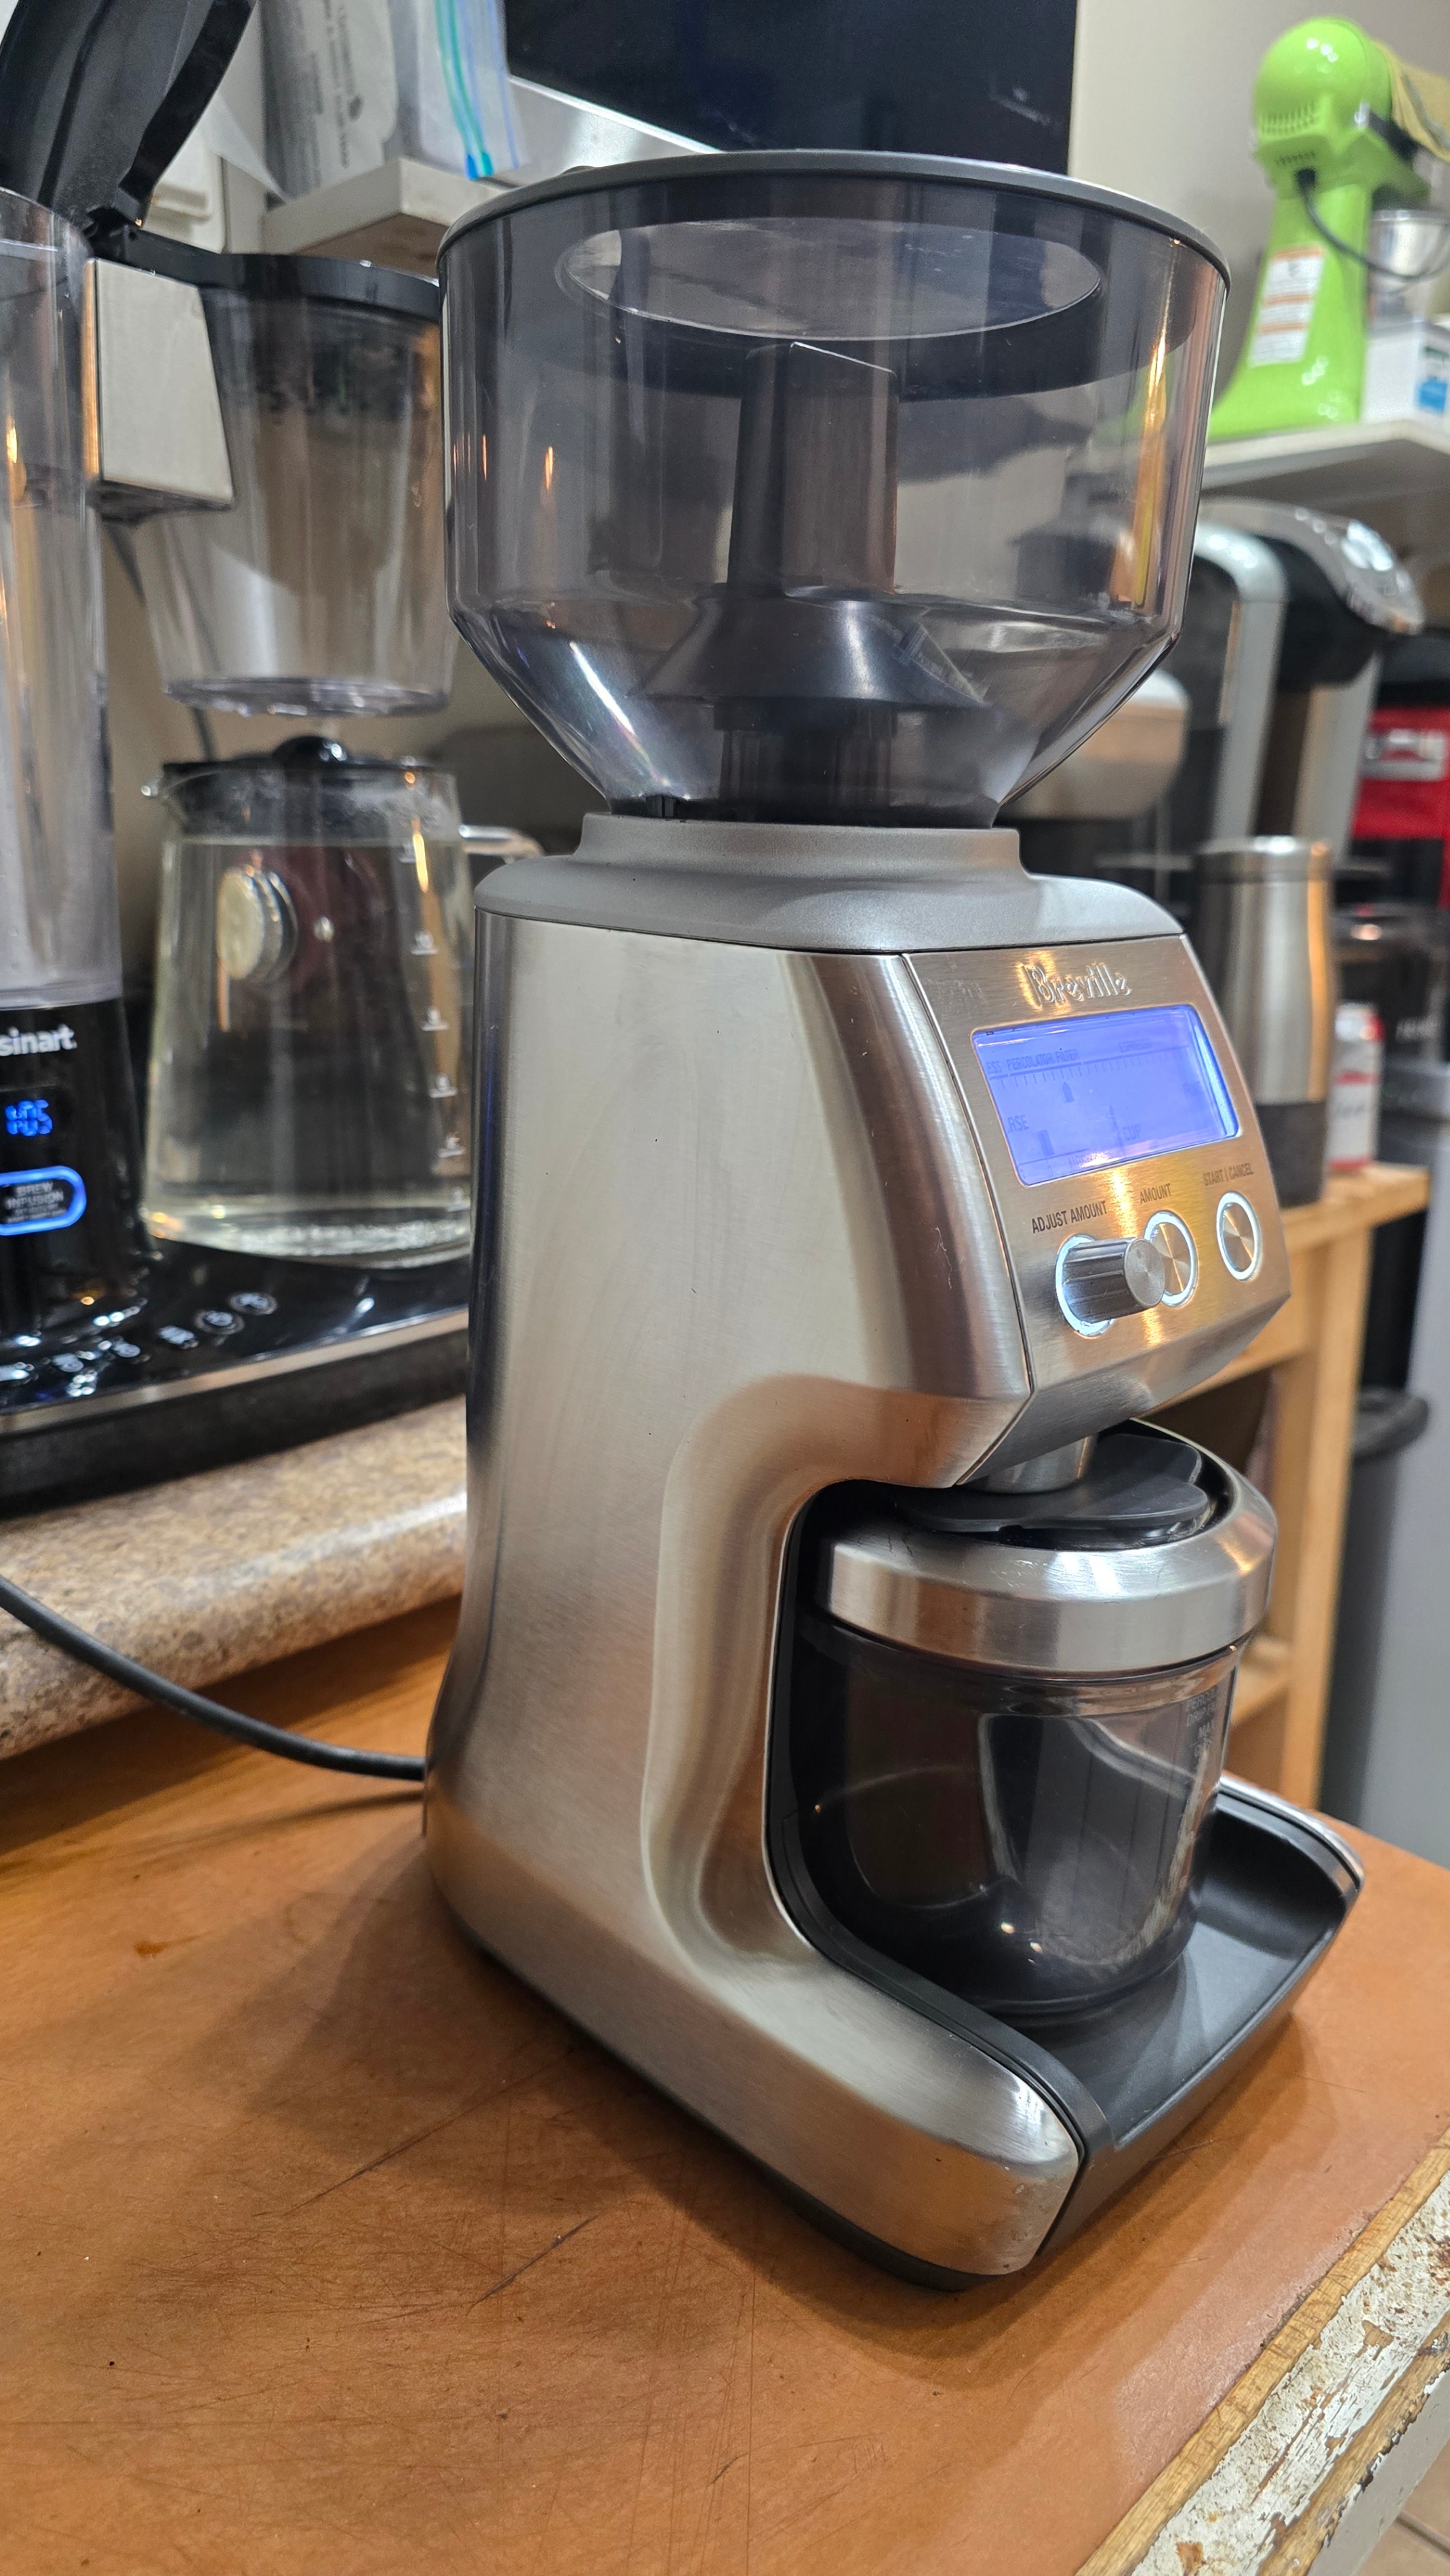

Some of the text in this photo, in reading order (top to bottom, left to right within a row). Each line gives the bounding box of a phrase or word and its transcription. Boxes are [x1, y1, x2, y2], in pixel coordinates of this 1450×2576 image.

[1020, 961, 1133, 1007] Breville
[1006, 1052, 1054, 1072] PERCOLATOR
[1055, 1049, 1080, 1064] FILTER
[1007, 1114, 1030, 1133] RSE
[1122, 1124, 1142, 1142] CUP
[1202, 1169, 1225, 1186] START
[1229, 1162, 1254, 1181] CANCEL
[1140, 1183, 1173, 1205] AMOUNT
[1031, 1200, 1108, 1234] ADJUST AMOUNT
